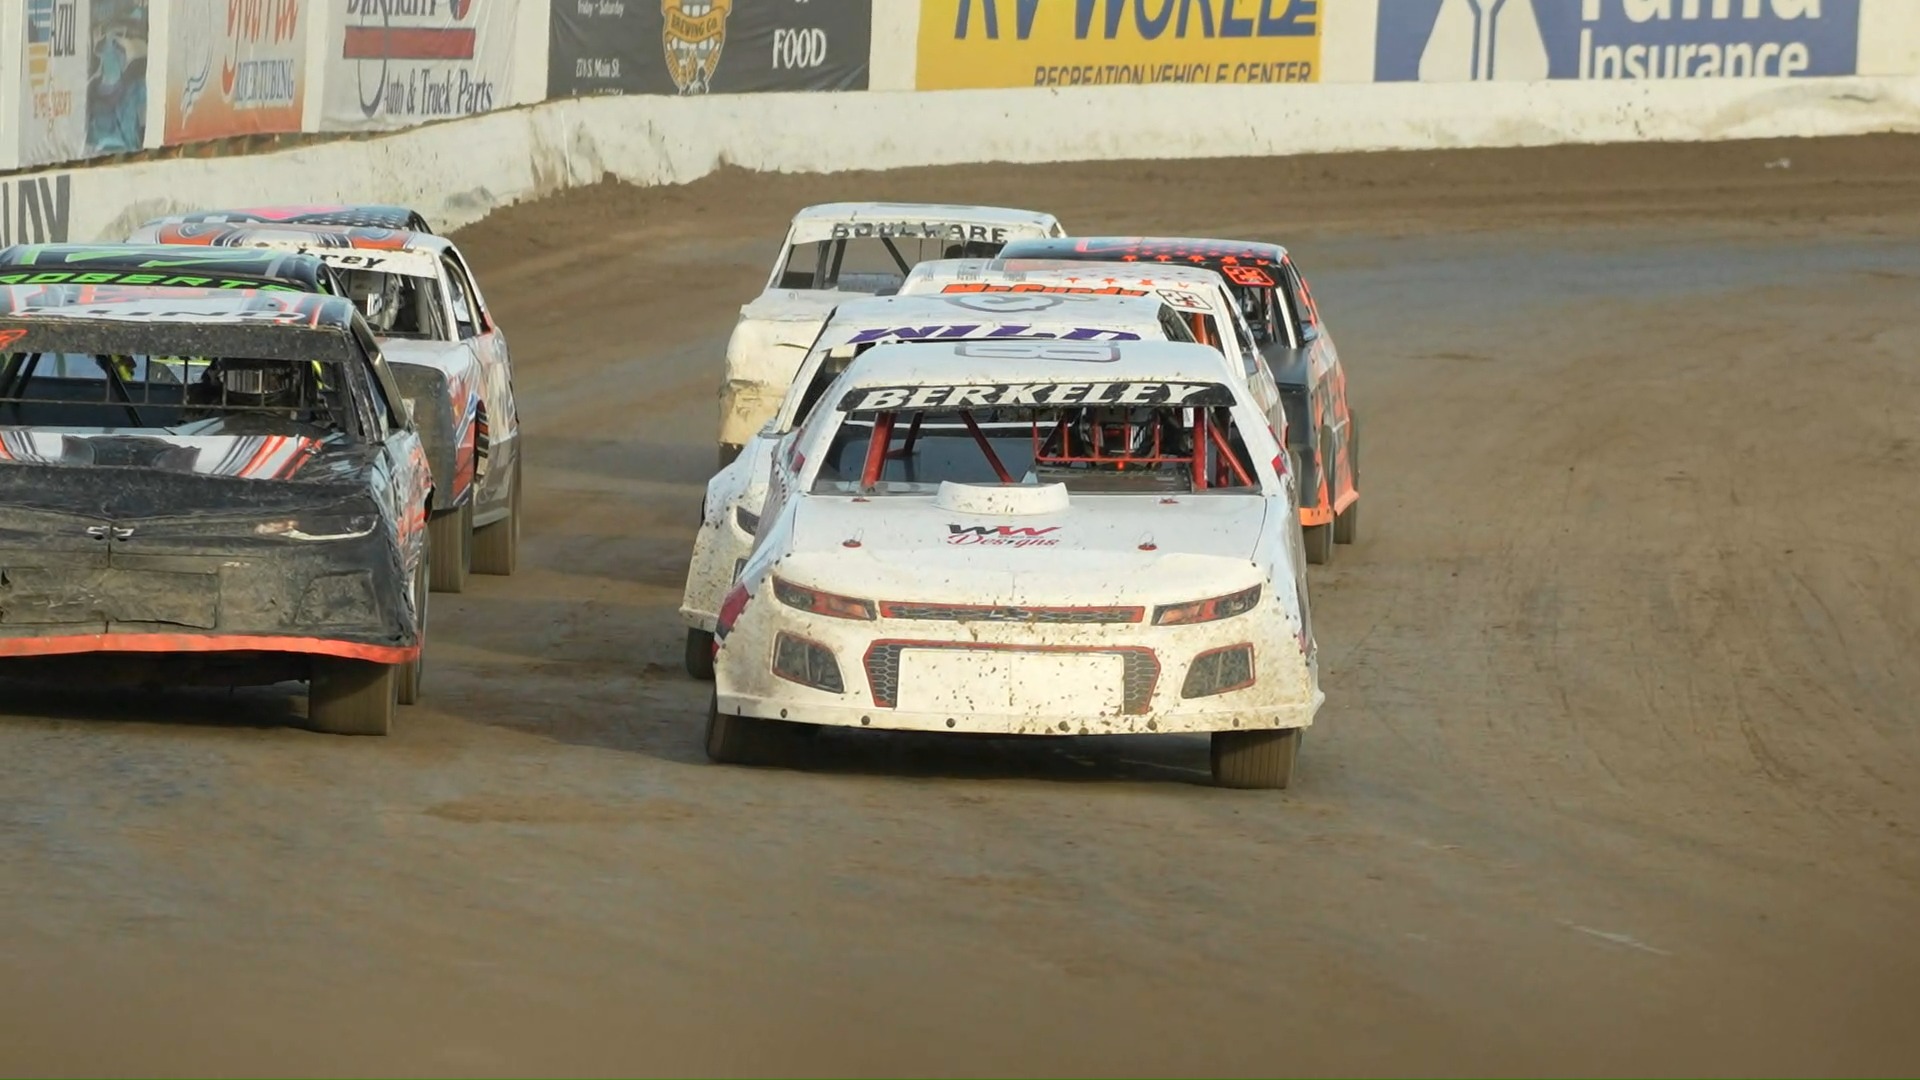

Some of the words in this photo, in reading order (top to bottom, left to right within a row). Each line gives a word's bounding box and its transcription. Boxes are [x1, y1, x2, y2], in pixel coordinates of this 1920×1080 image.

[772, 28, 827, 69] FOOD
[1579, 28, 1809, 80] Insurance
[1033, 65, 1146, 86] RECREATION
[1232, 62, 1312, 83] CENTER
[384, 69, 405, 114] Auto
[406, 68, 417, 115] &
[421, 69, 453, 115] Truck
[456, 68, 494, 114] Parts
[847, 324, 1142, 345] WILD
[858, 383, 1207, 409] BERKELEY
